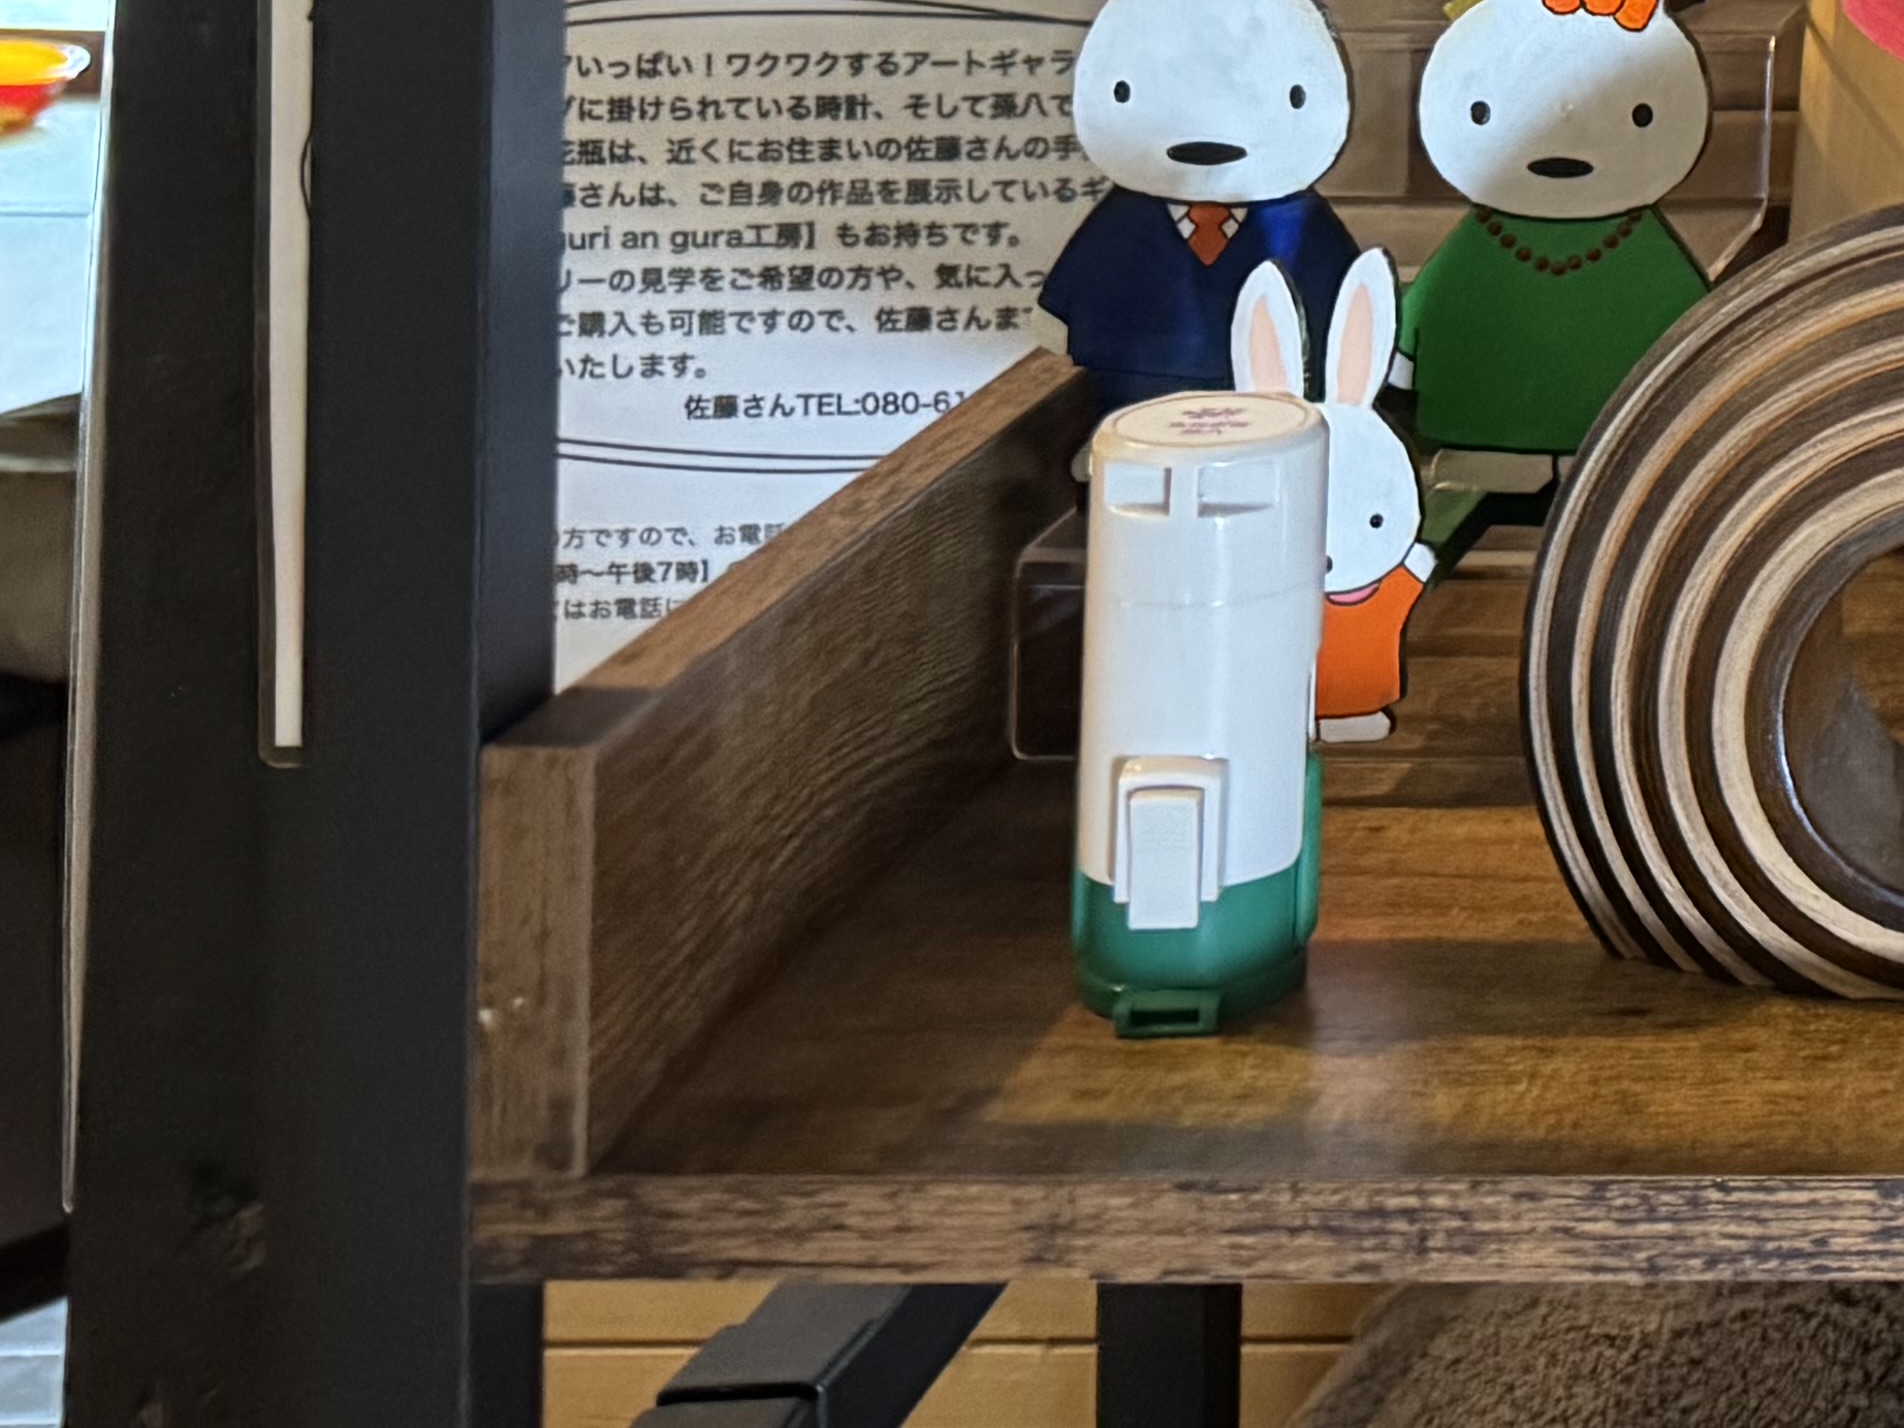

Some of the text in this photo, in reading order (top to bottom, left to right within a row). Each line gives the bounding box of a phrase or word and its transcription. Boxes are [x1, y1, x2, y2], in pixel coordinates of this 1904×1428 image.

[564, 50, 1074, 79] いっぱい!ワクワクするアートギャラ
[562, 135, 1089, 166] 瓶は、近くにお住まいの佐藤さんの手
[560, 225, 610, 251] uri
[620, 230, 660, 250] an
[558, 305, 1033, 337] ご購入も可能ですので、佐藤さんま
